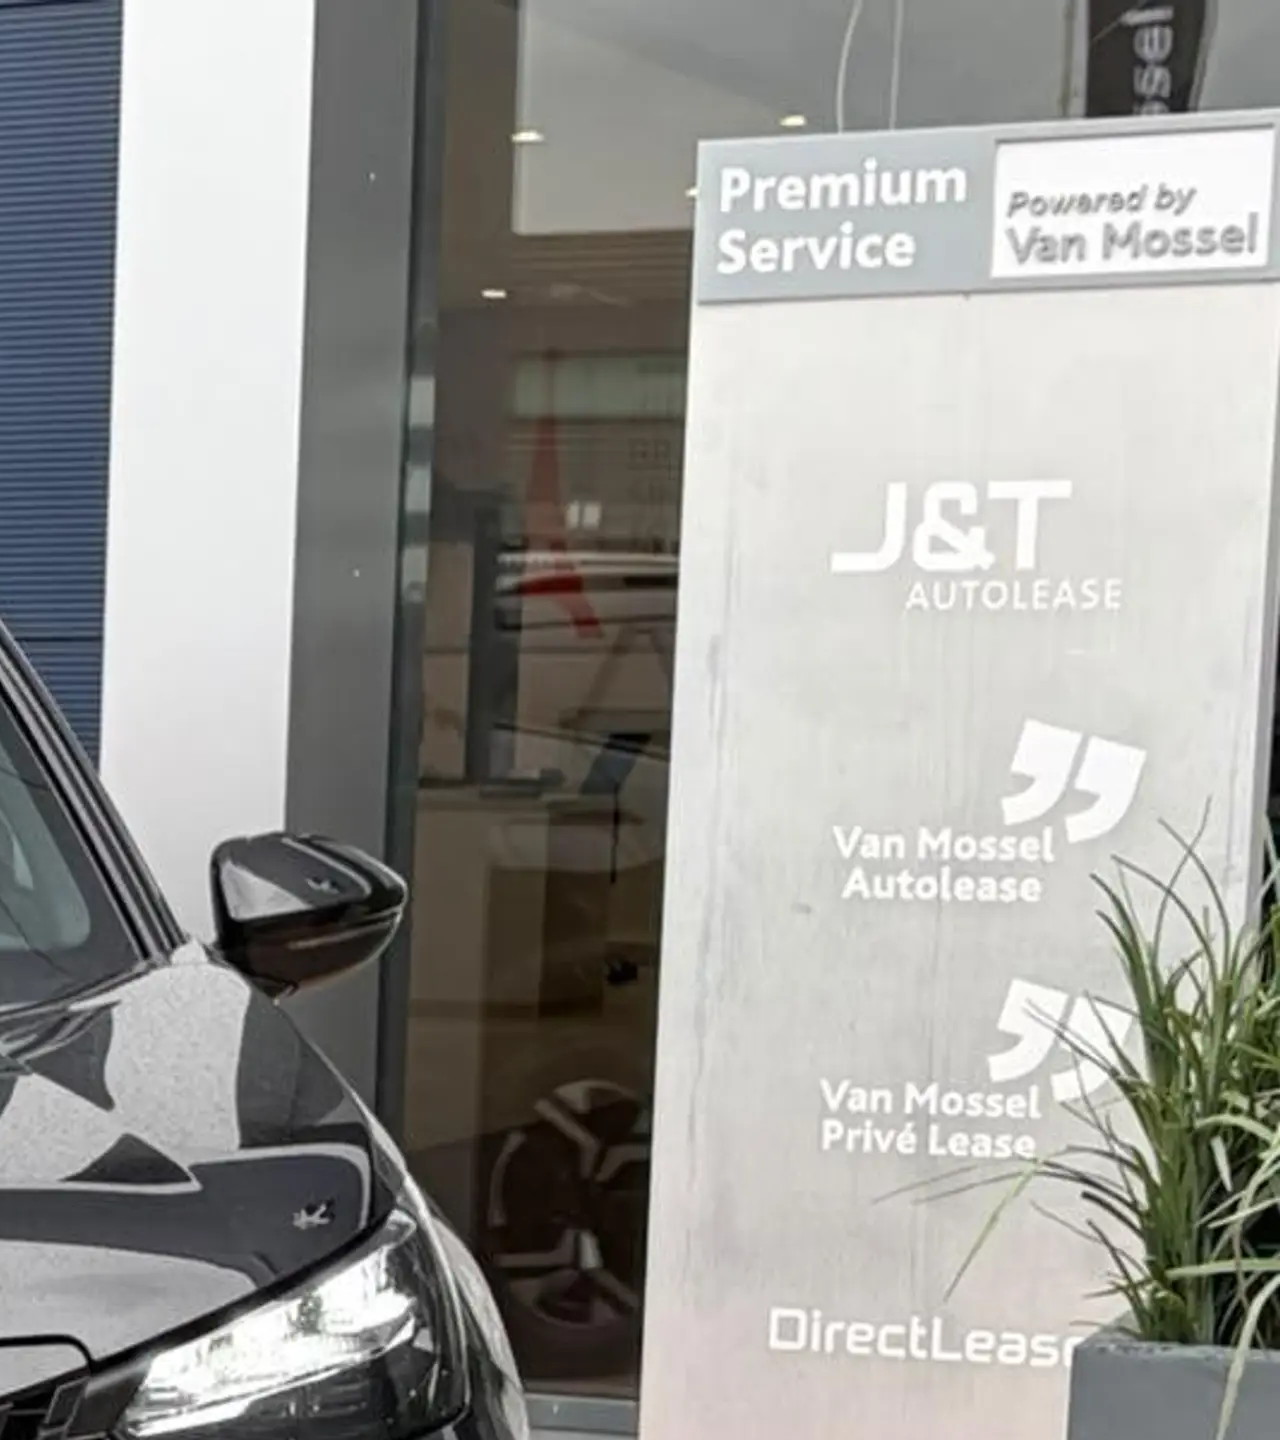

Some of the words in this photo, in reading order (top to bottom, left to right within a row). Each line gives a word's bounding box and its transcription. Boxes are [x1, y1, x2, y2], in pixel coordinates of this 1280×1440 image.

[720, 158, 967, 211] Premium
[1006, 184, 1146, 218] Powered
[1155, 184, 1196, 214] by
[717, 223, 916, 274] Service
[1005, 227, 1086, 265] Van
[1102, 212, 1258, 261] Mossel
[831, 480, 1072, 572] J&T
[905, 579, 1122, 610] AUTOLEASE
[833, 826, 906, 859] Van
[917, 826, 1055, 862] Mossel
[842, 867, 1042, 903] Autolease
[820, 1079, 892, 1114] Van
[904, 1083, 1042, 1119] Mossel
[822, 1120, 917, 1156] Privé
[929, 1124, 1037, 1159] Lease
